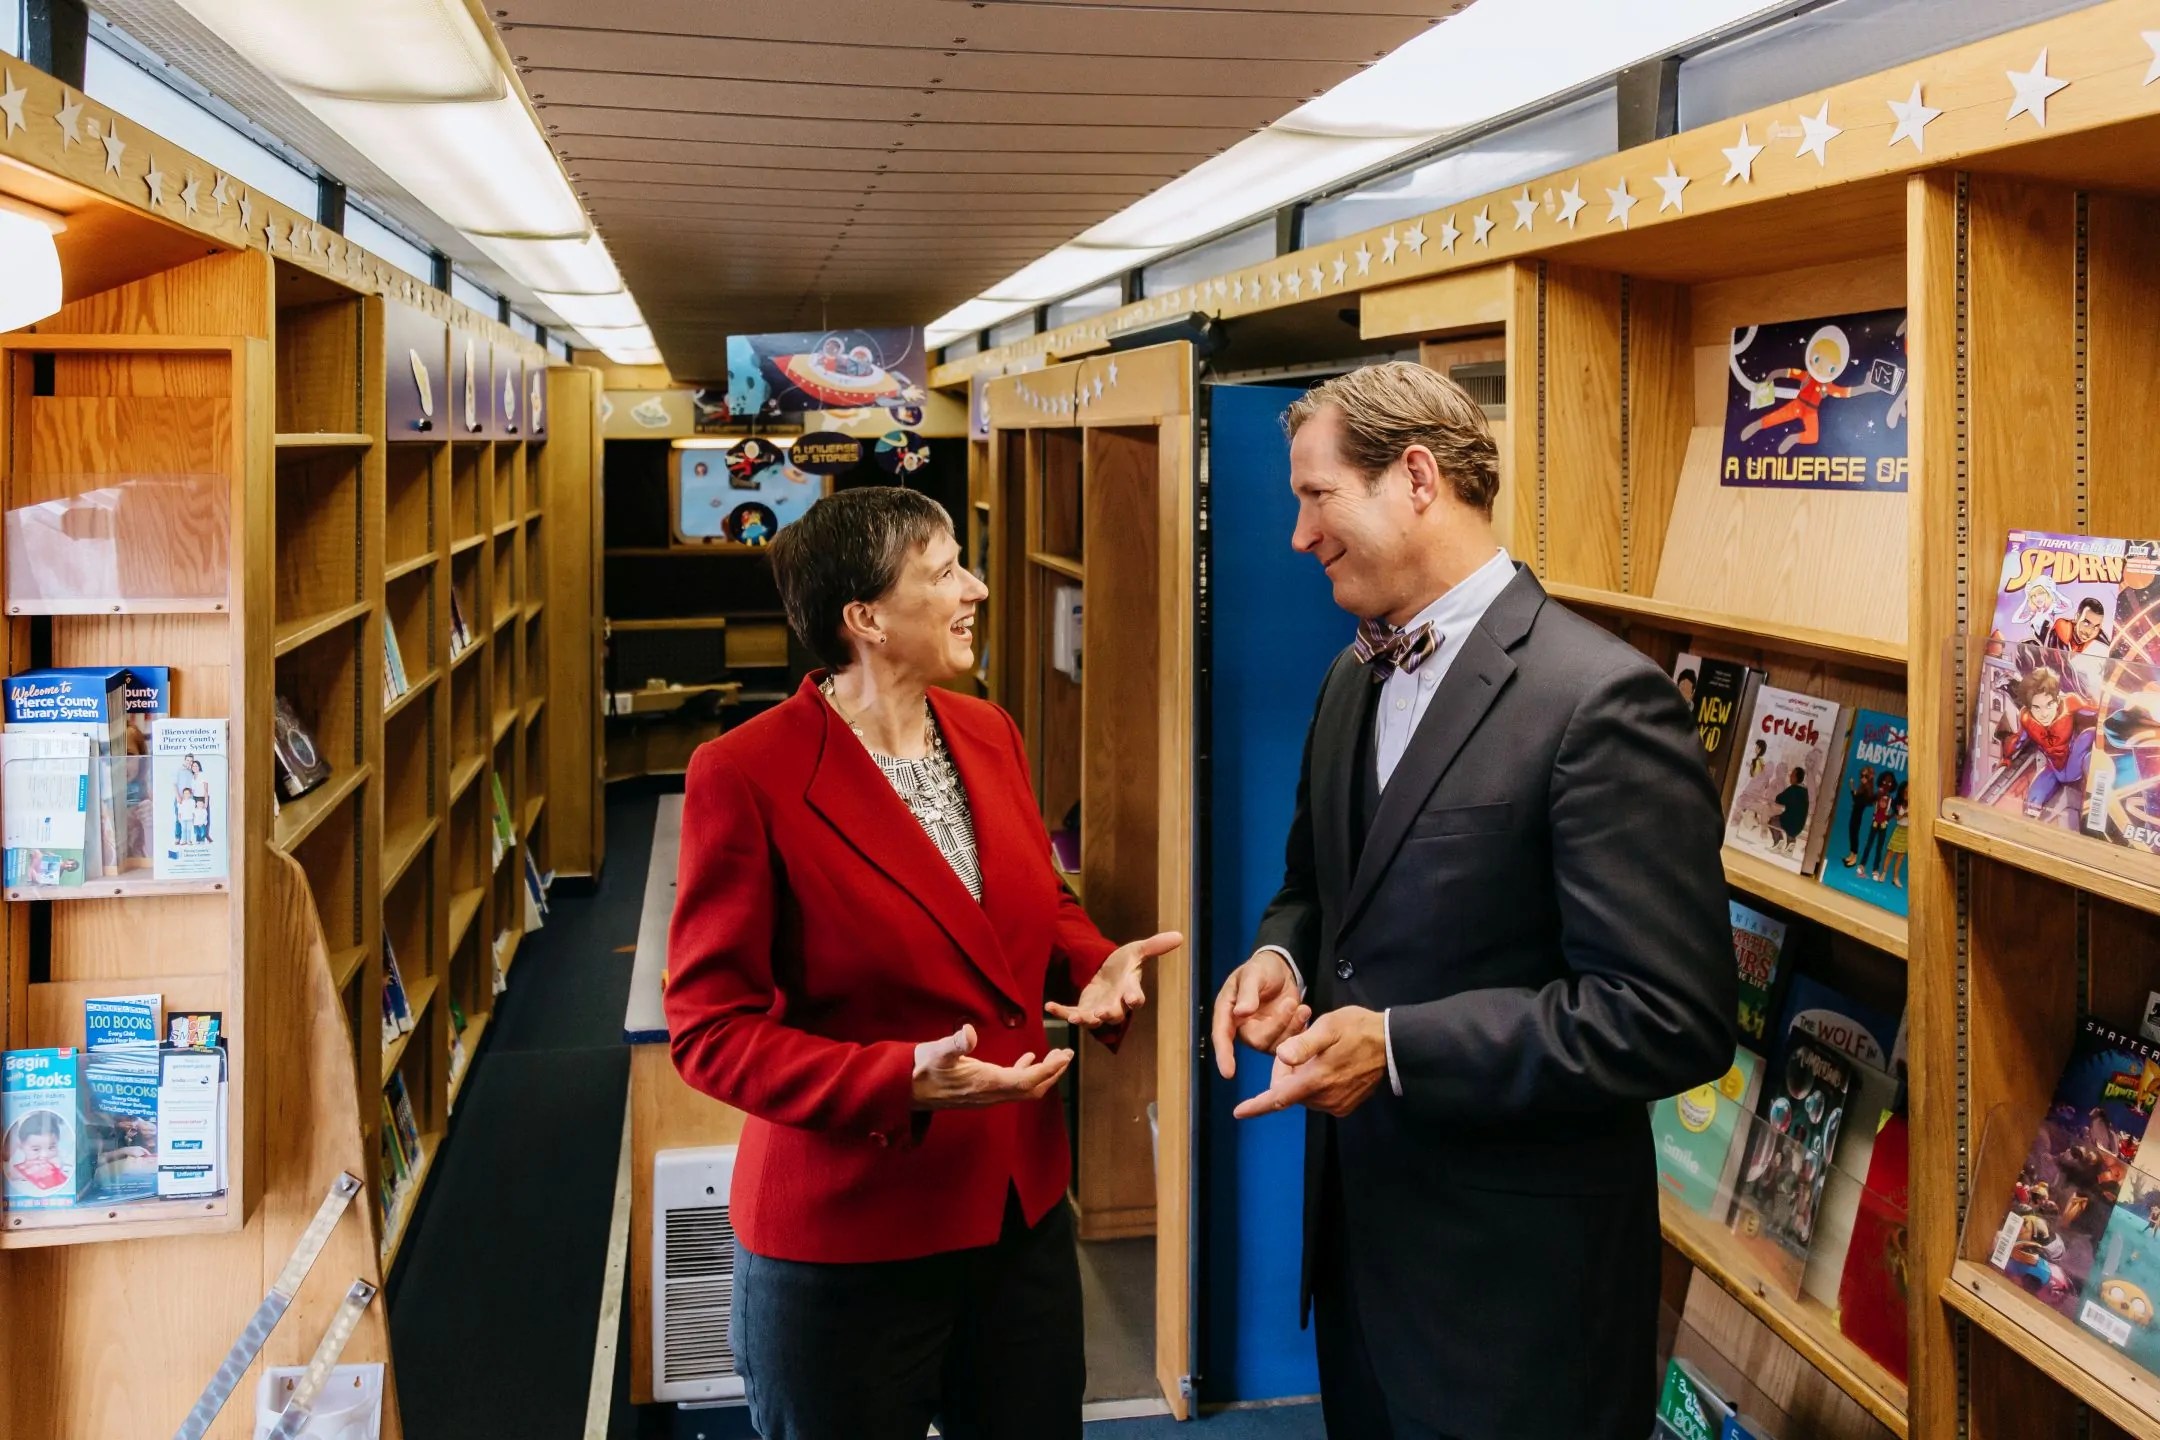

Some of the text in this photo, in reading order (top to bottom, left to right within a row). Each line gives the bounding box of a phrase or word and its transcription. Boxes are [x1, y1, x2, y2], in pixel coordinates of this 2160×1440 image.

[792, 443, 859, 454] A UNIVERSE
[793, 453, 859, 464] OF STORIES
[1725, 456, 1740, 479] A
[1746, 456, 1867, 482] UNIVERSE
[2038, 538, 2085, 551] MARVEL
[11, 681, 73, 700] Welcome to
[125, 687, 159, 699] ounty
[16, 696, 99, 709] Pierce County
[125, 699, 159, 711] ystem
[17, 707, 99, 720] Library System
[1698, 696, 1732, 724] NEW
[159, 744, 187, 752] Library
[89, 1015, 152, 1030] 100 BOOKS
[1800, 1015, 1816, 1033] THE
[1817, 1019, 1868, 1058] WOLF
[6, 1053, 50, 1072] Begin
[6, 1071, 25, 1082] with
[25, 1071, 72, 1088] Books
[91, 1082, 157, 1098] 100 BOOKS
[98, 1103, 157, 1116] Kindergarten
[1662, 1134, 1700, 1174] Smile
